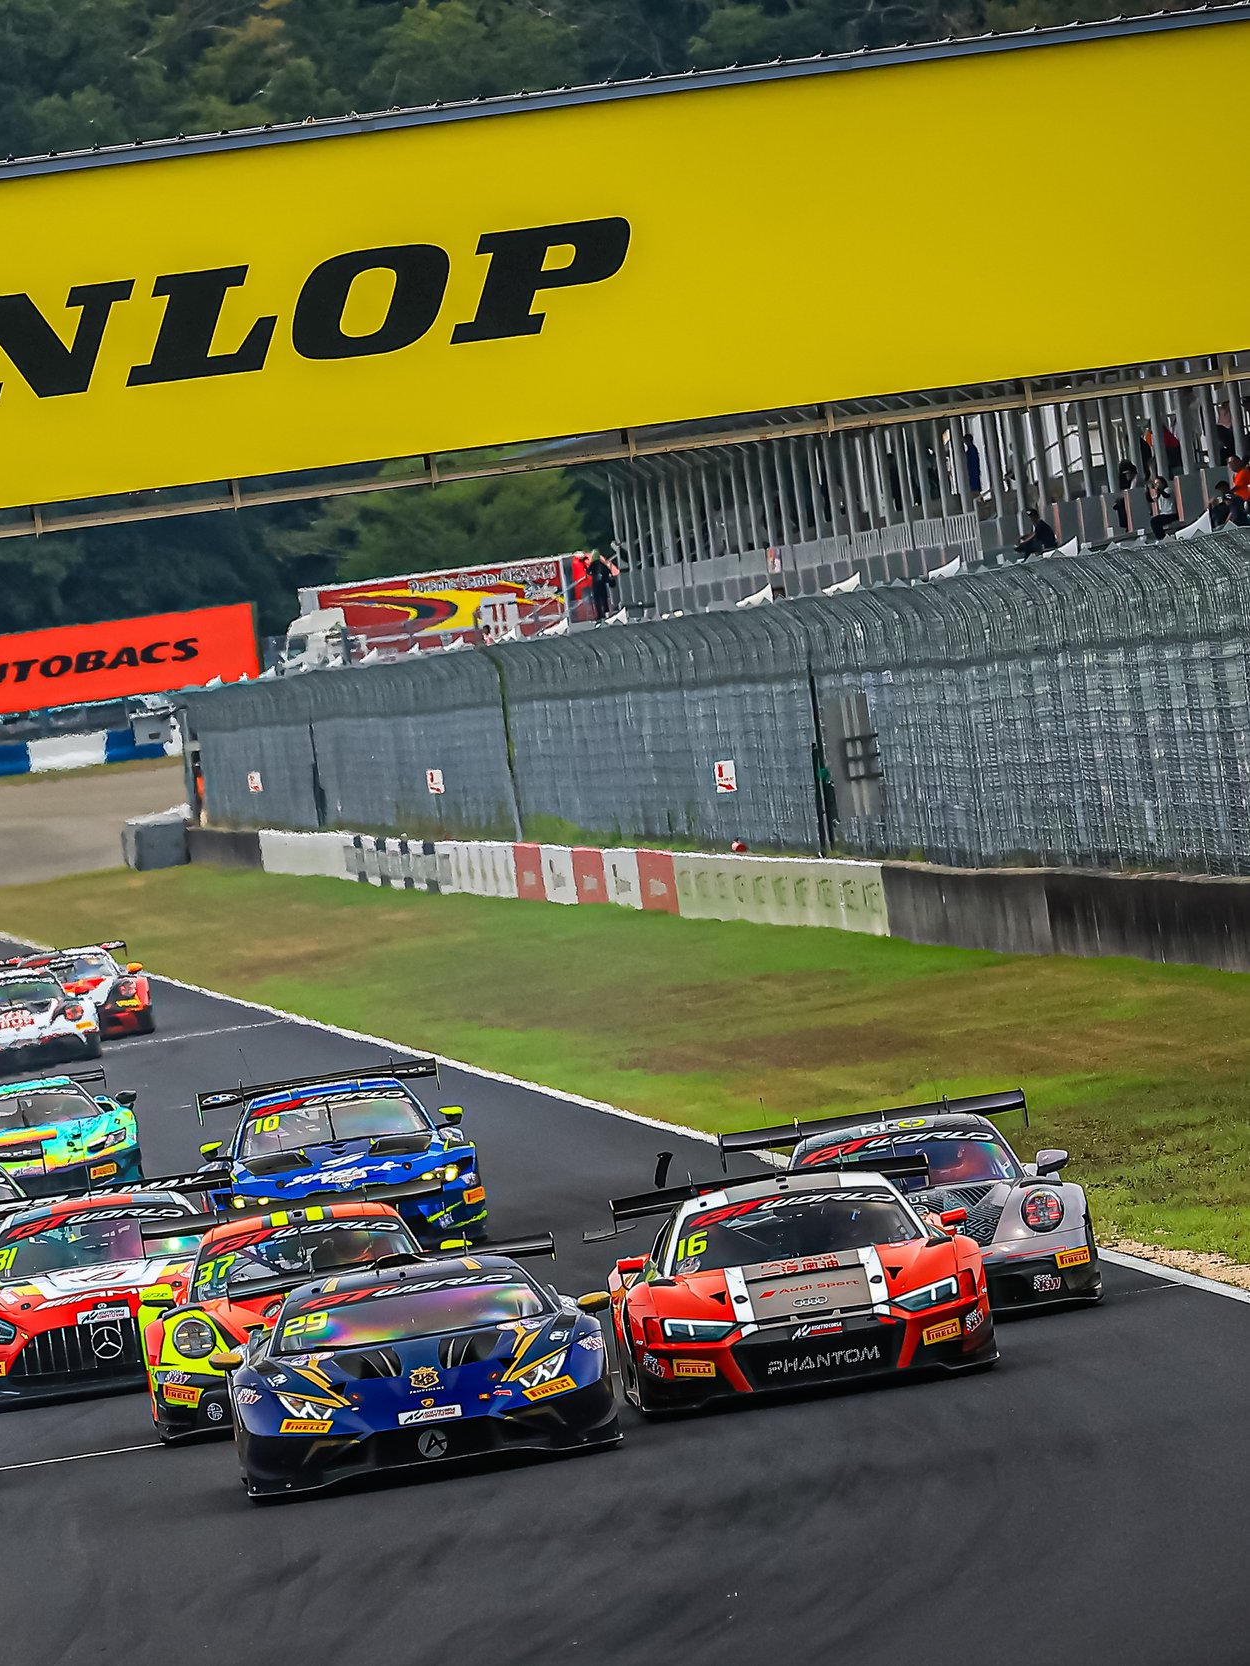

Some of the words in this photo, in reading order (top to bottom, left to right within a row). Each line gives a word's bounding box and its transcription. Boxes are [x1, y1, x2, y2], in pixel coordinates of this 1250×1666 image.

[254, 1115, 281, 1136] 10
[865, 1130, 994, 1149] WORLD
[758, 1191, 896, 1211] WORLD
[66, 1207, 185, 1225] WORLD
[272, 1221, 401, 1240] WORLD
[677, 1231, 708, 1262] 16
[1059, 1250, 1089, 1265] PIRELLI
[194, 1255, 237, 1288] 37
[372, 1274, 514, 1298] WORLD
[779, 1284, 813, 1295] Audi
[816, 1279, 860, 1290] Sport
[282, 1311, 329, 1337] 29
[926, 1321, 958, 1341] PIRELLI
[677, 1362, 711, 1374] PIRELLI
[768, 1344, 881, 1375] PHANTOM
[165, 1385, 196, 1401] PIRELLI
[530, 1379, 571, 1398] PIRELLI
[283, 1421, 329, 1432] PIRELLI
